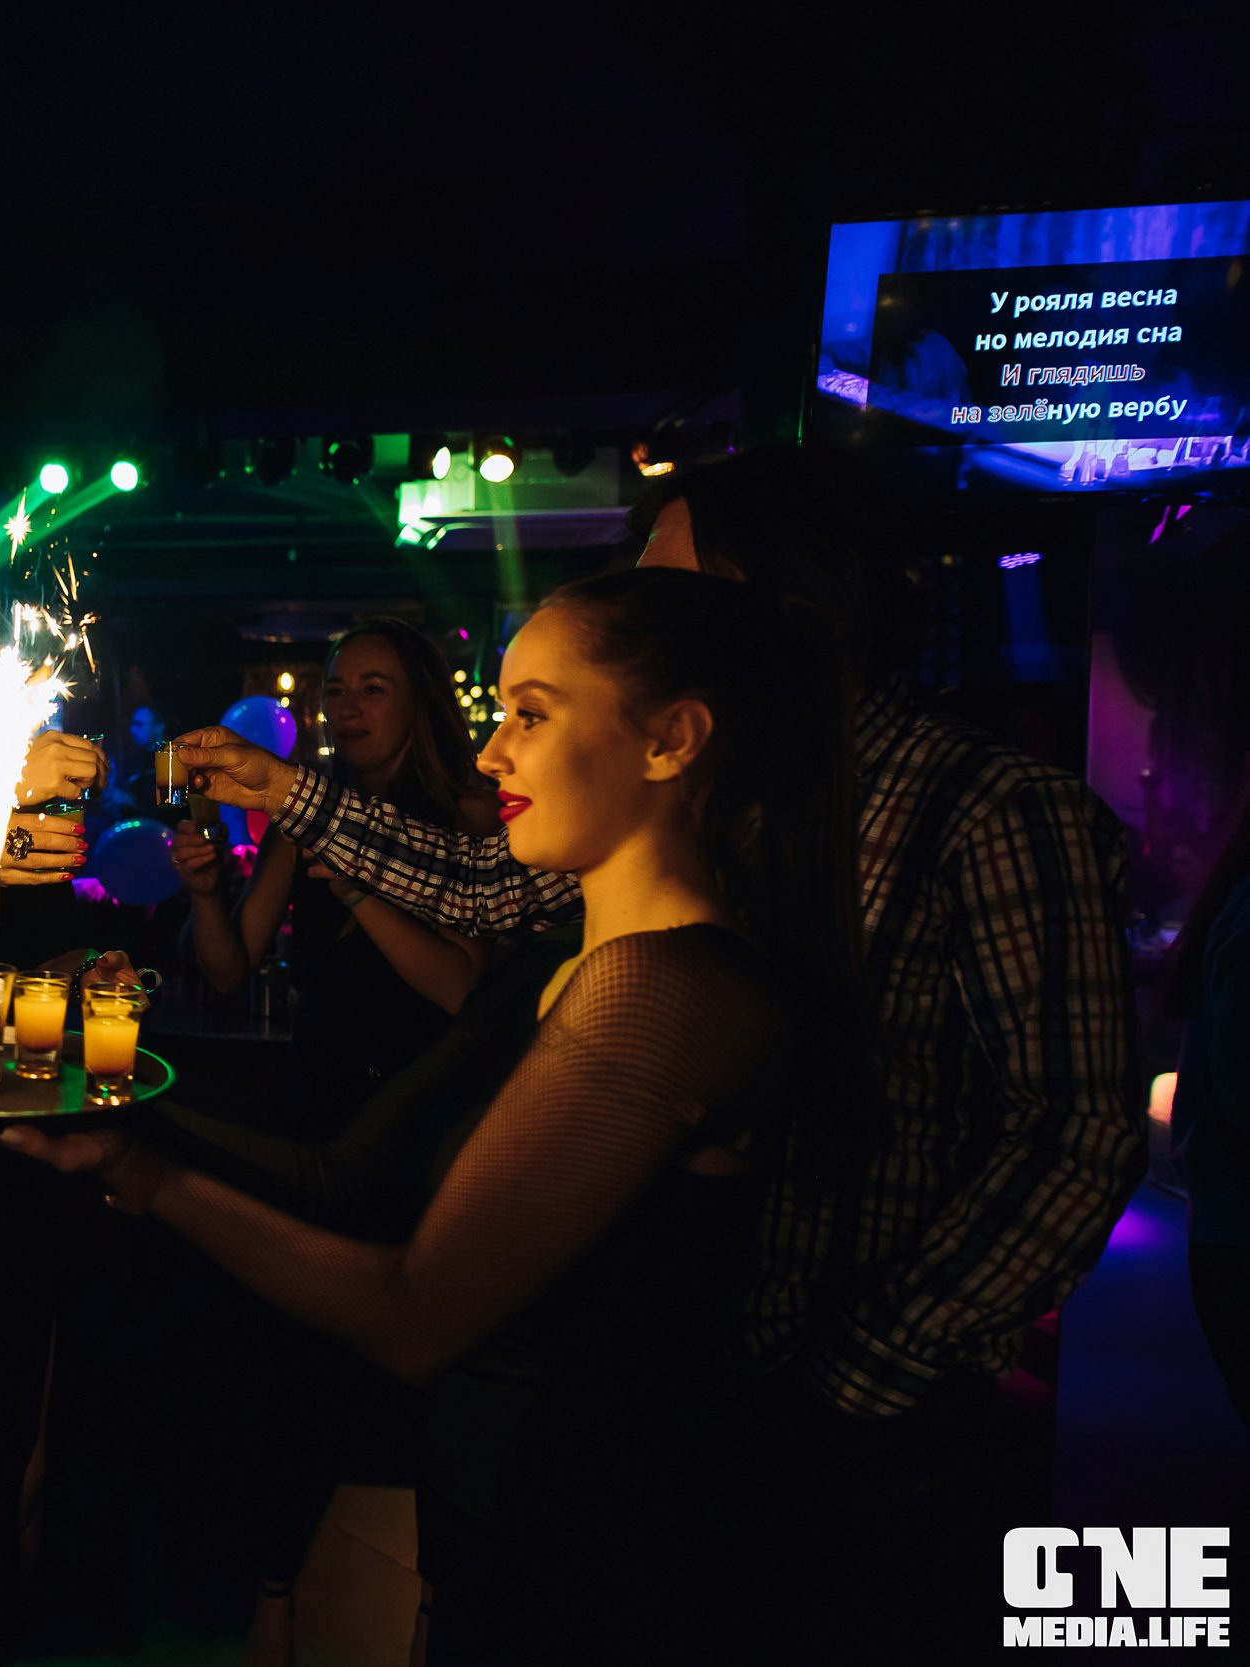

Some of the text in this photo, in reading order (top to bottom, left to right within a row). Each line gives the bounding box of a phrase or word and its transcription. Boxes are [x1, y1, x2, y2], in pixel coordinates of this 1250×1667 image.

[990, 286, 1178, 318] У рояля весна
[974, 323, 1183, 351] но мелодия сна
[1001, 363, 1146, 387] И глядишь
[951, 395, 1188, 425] на зелёную вербу
